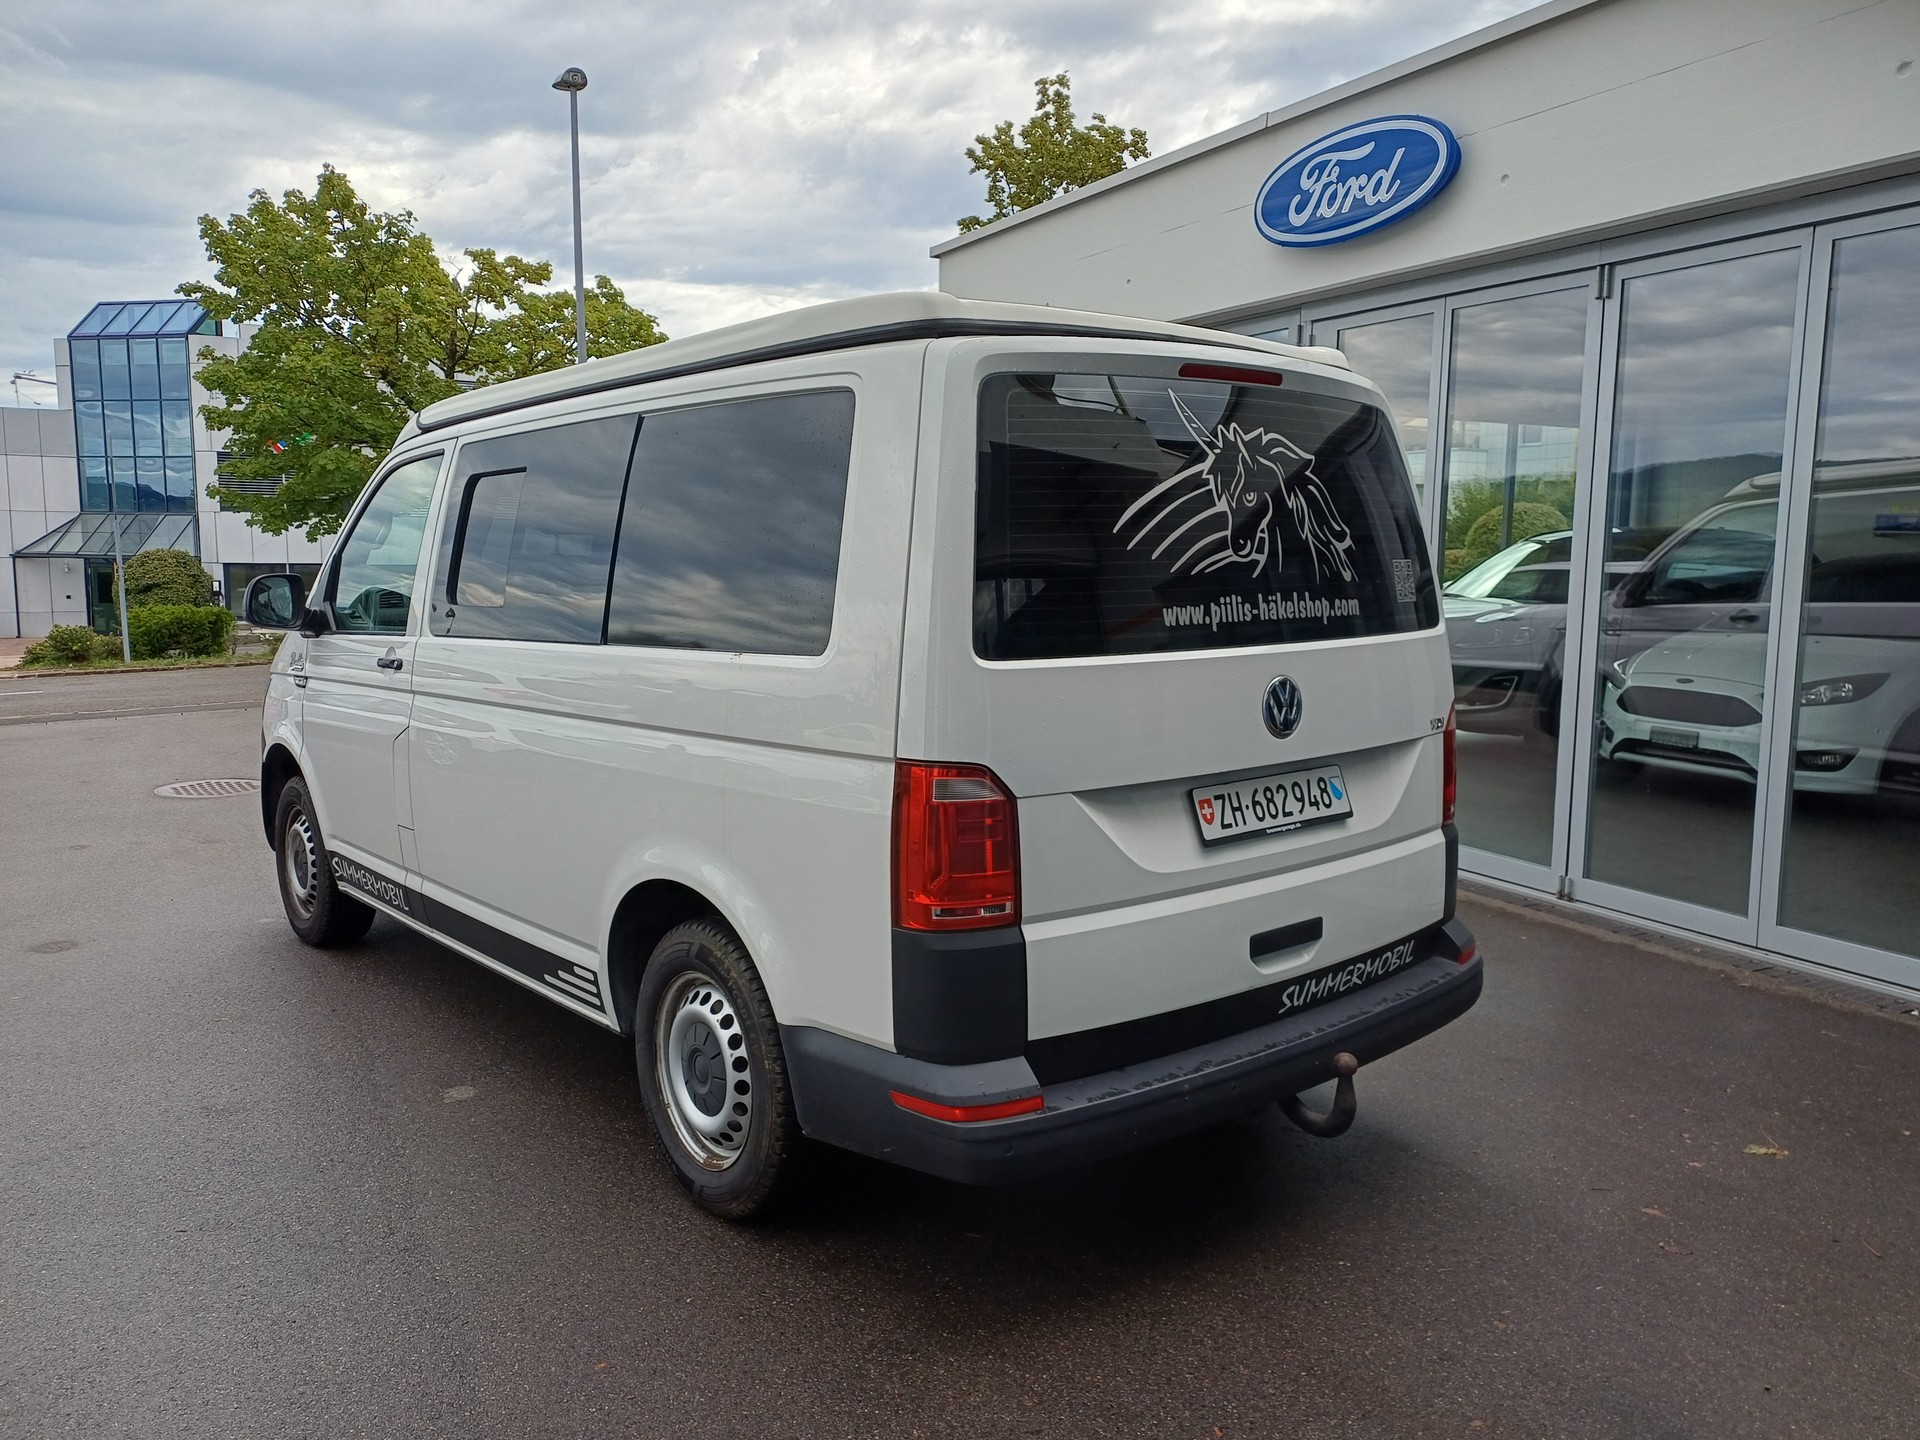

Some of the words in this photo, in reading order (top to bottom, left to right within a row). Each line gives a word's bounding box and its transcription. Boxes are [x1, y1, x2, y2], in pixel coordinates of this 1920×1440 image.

[1288, 140, 1406, 227] Ford
[1163, 591, 1360, 632] www.piilis-häkelshop.com
[332, 857, 409, 911] SUMMERMOBIL
[1278, 940, 1415, 1014] SUMMERMOBIL
